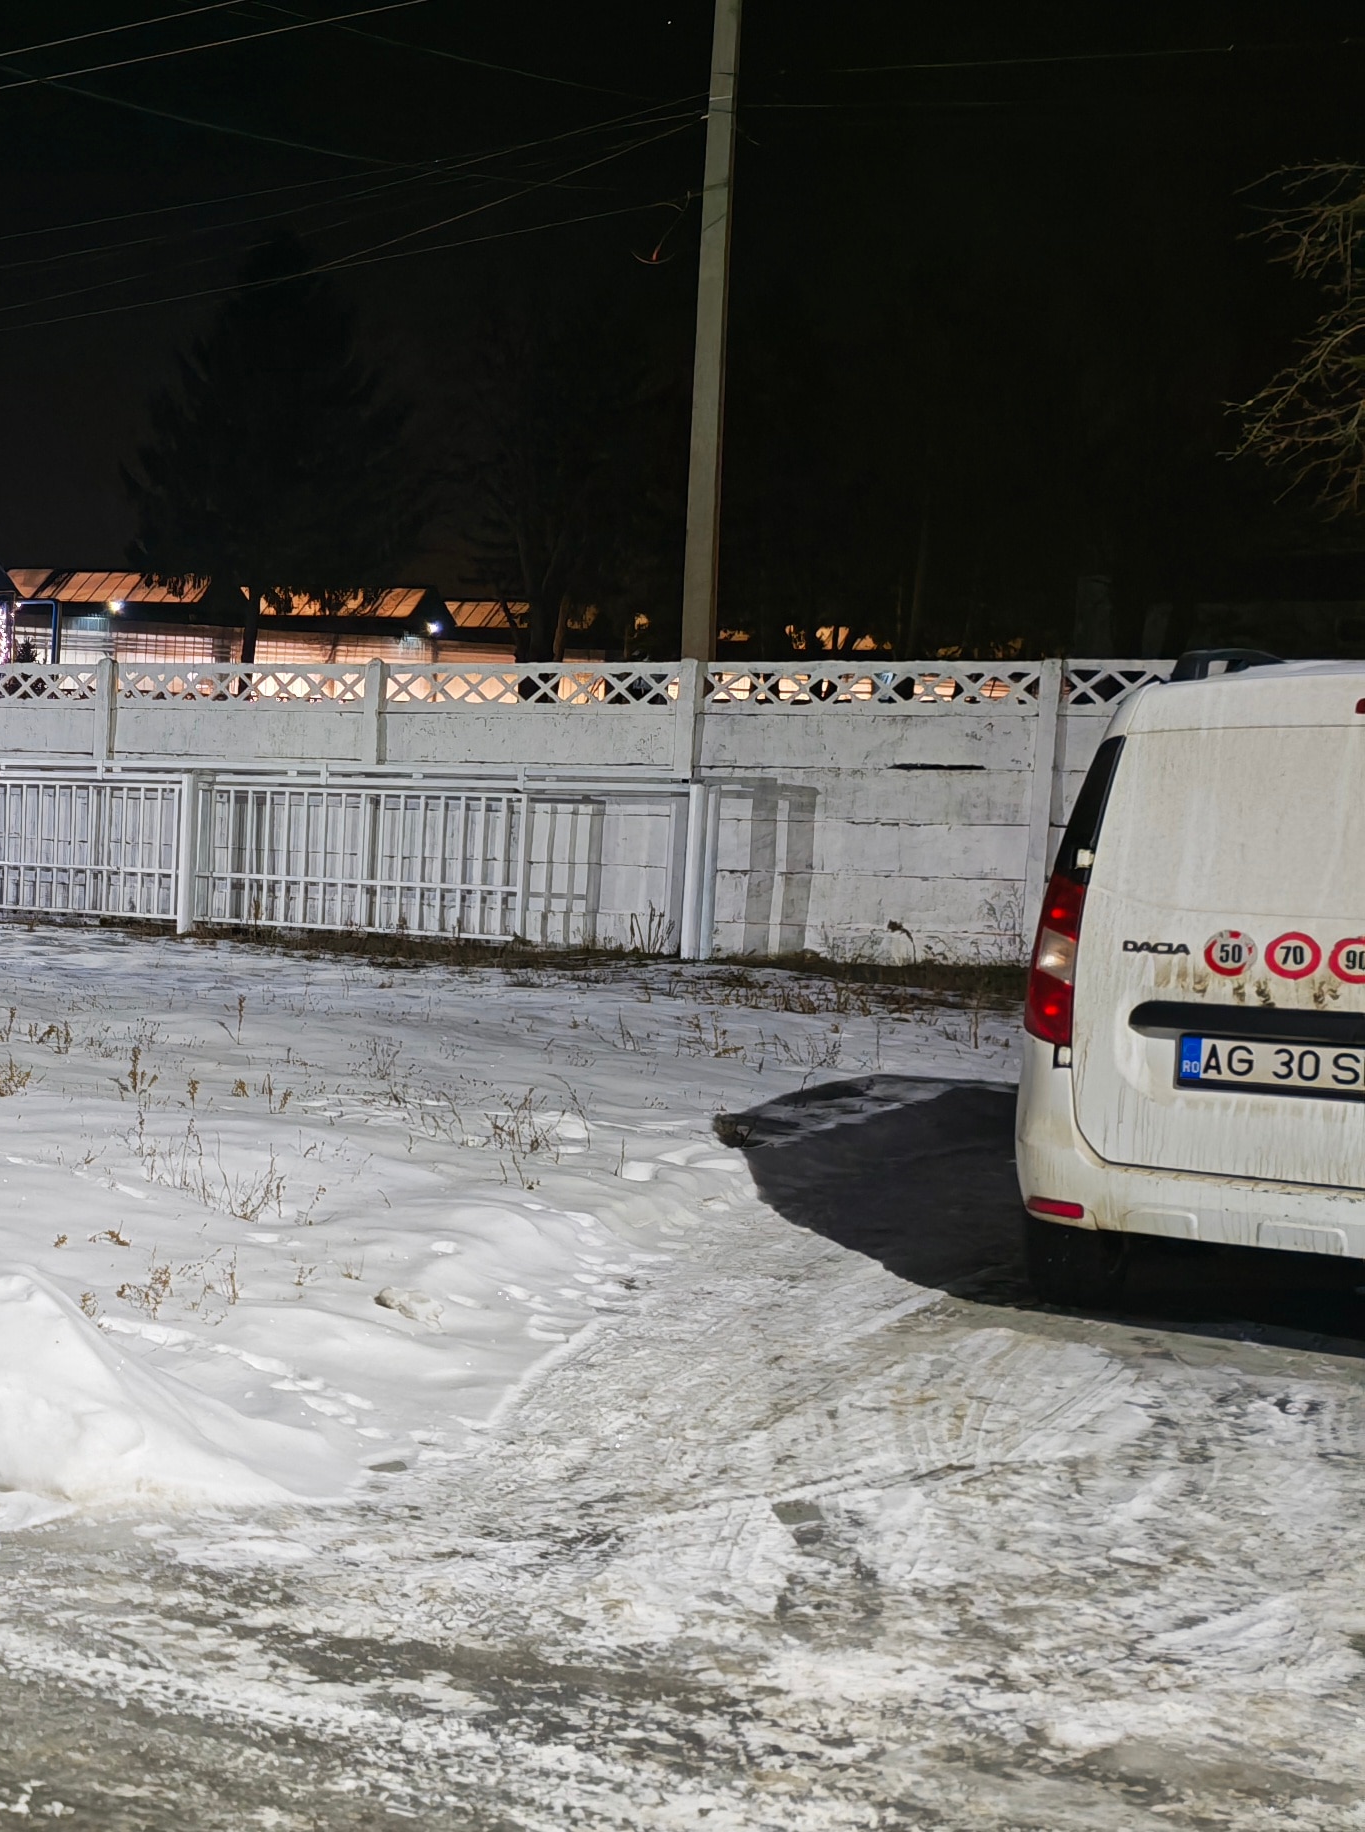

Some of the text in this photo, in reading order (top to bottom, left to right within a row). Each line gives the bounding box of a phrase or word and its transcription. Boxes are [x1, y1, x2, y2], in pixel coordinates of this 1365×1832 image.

[1122, 940, 1191, 956] DACIA
[1219, 943, 1243, 964] 50
[1279, 945, 1304, 965] 70
[1182, 1060, 1200, 1074] RO
[1202, 1043, 1365, 1085] AG 30 S
